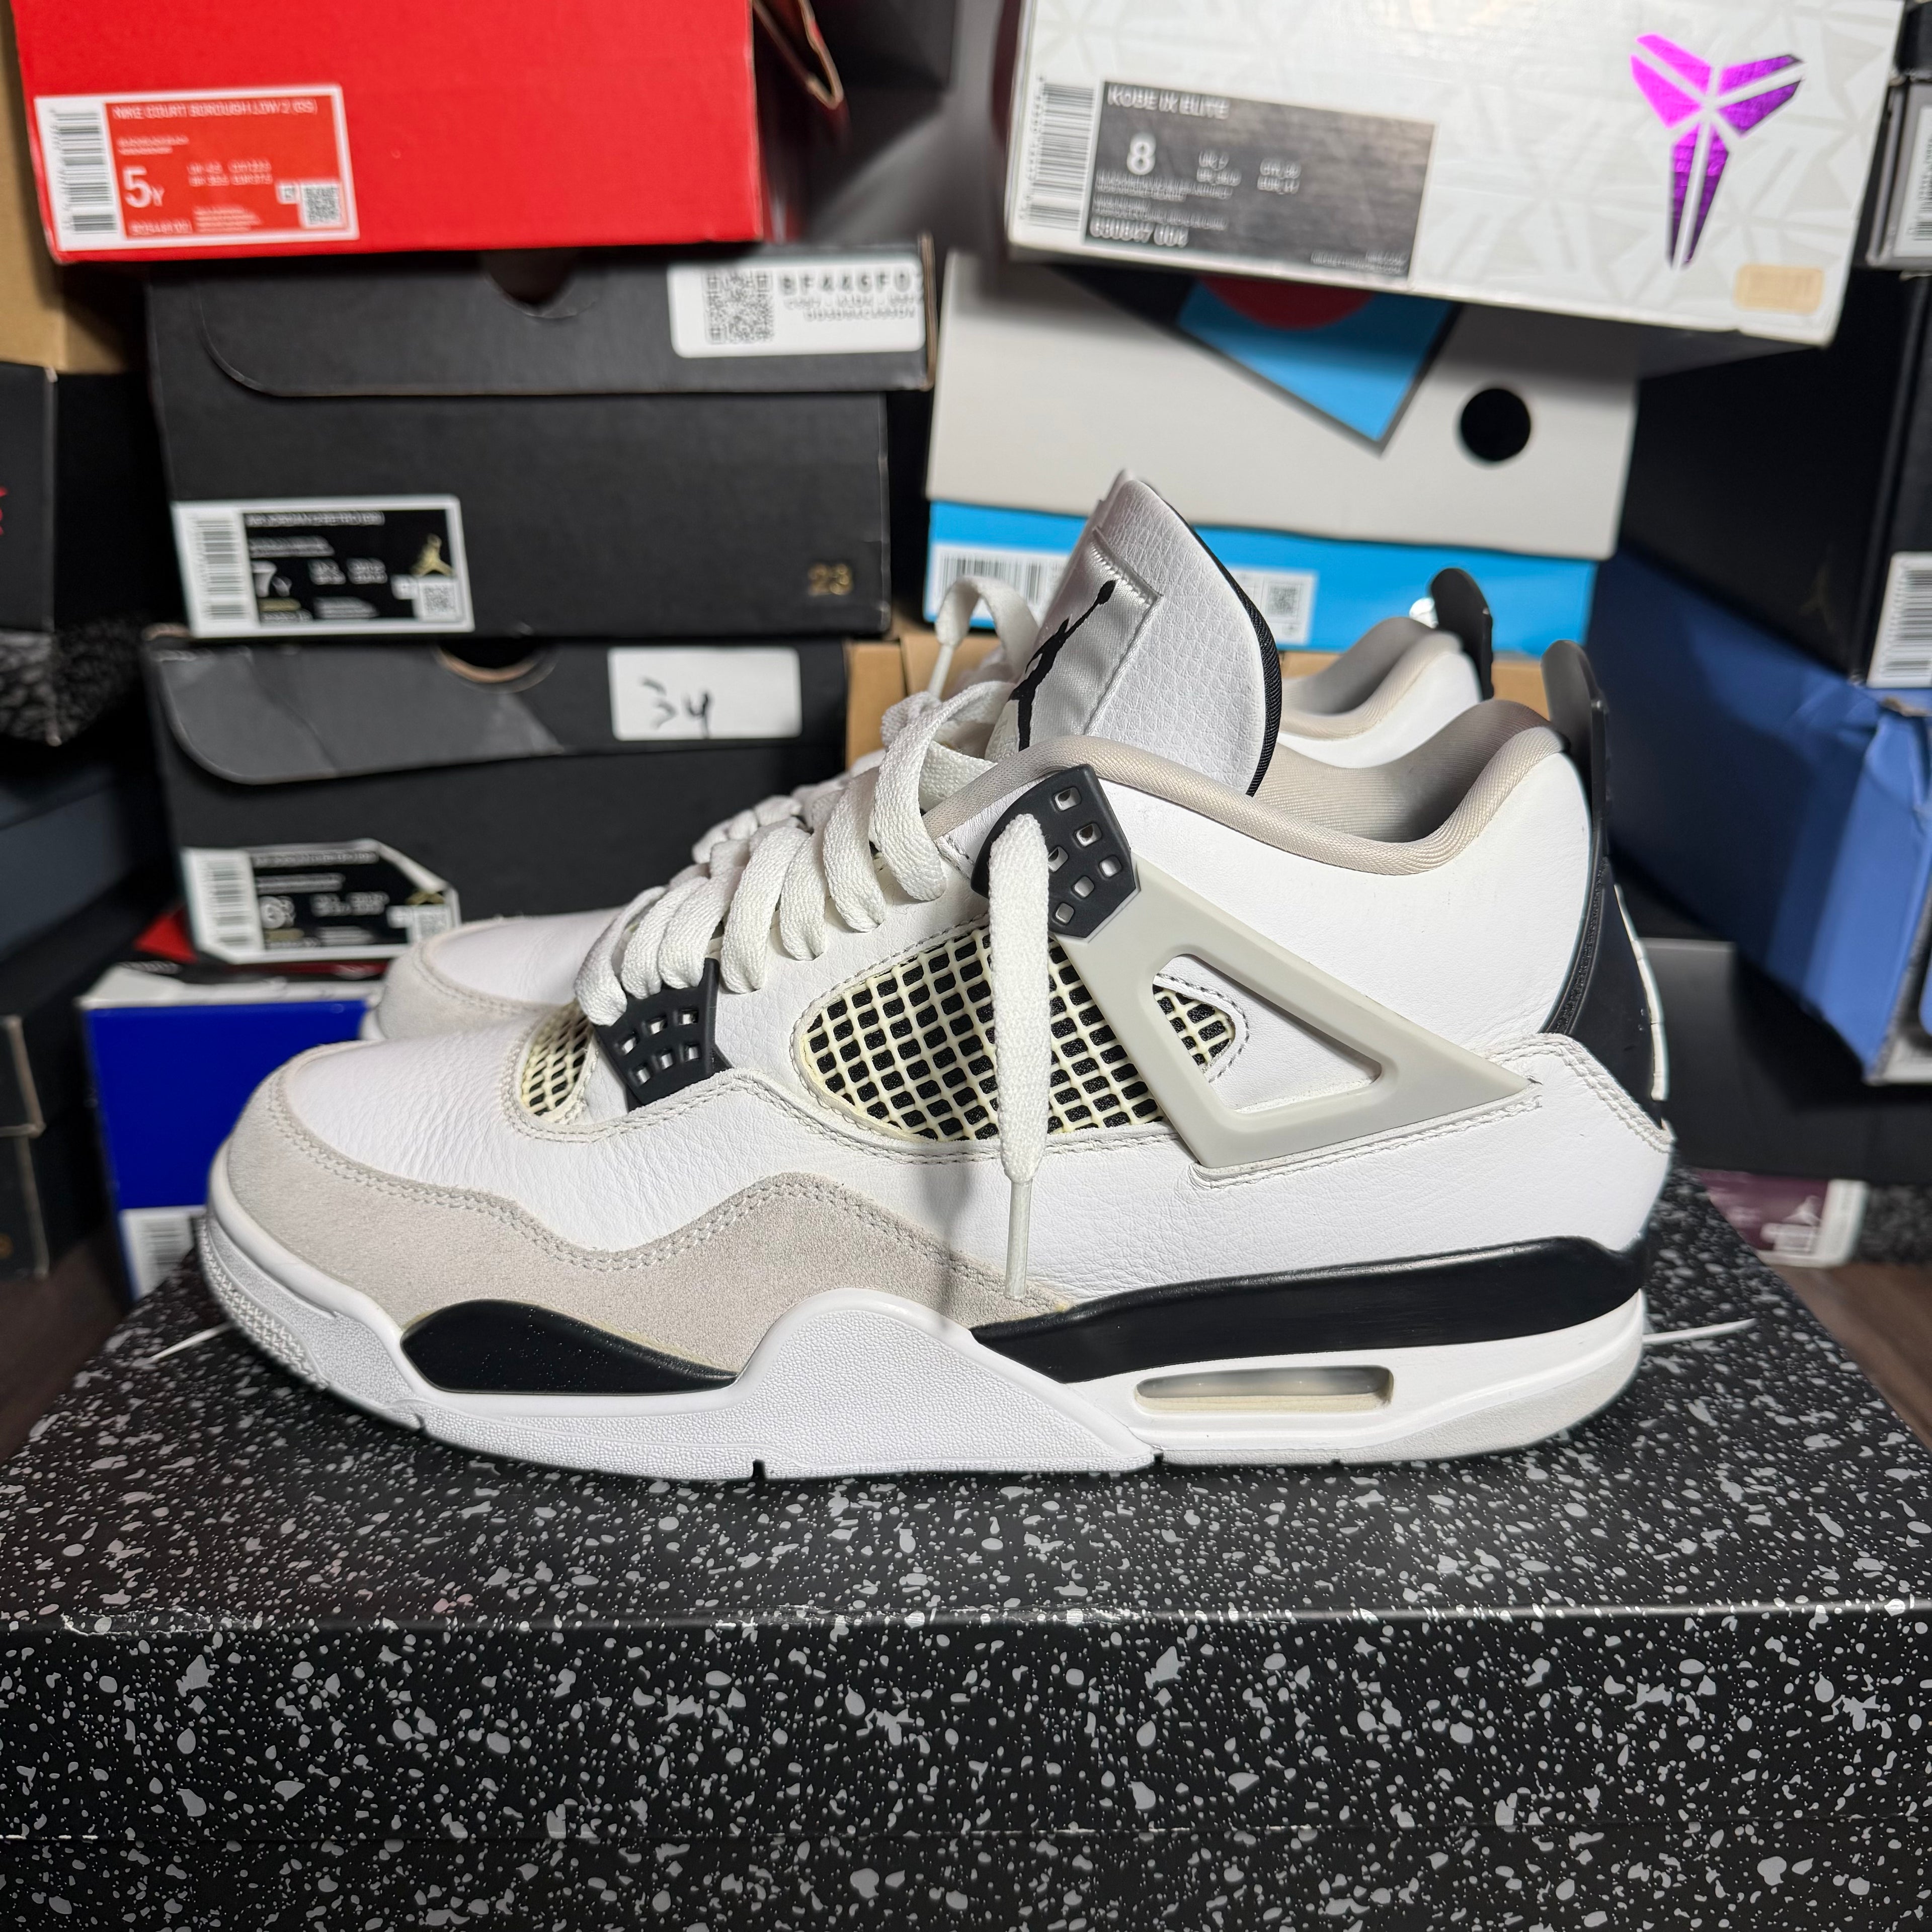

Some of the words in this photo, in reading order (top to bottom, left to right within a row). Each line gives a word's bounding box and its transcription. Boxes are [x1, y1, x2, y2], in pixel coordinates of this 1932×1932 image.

[112, 105, 143, 120] NIKE
[144, 103, 187, 118] COURT
[1107, 85, 1157, 111] KOBE
[1179, 92, 1230, 120] ELITE
[1126, 133, 1156, 175] 8
[808, 562, 853, 597] 23
